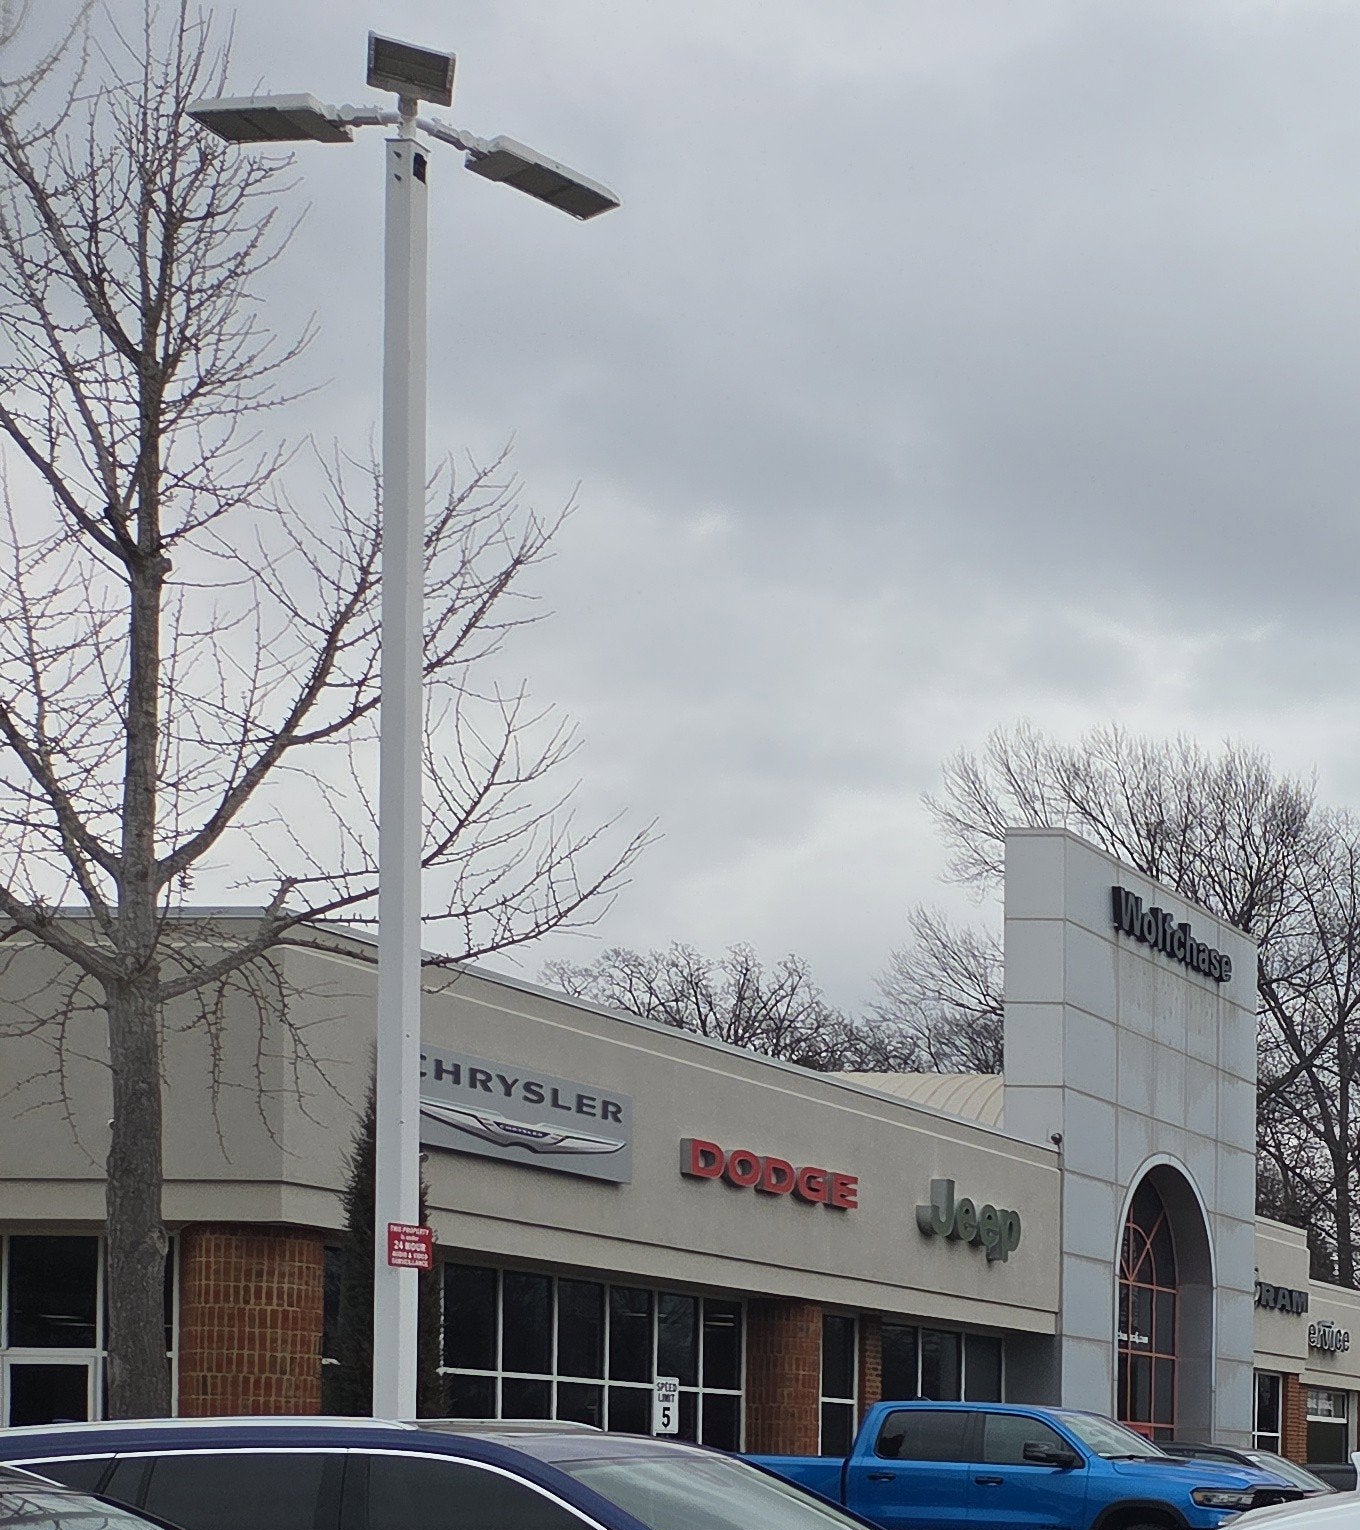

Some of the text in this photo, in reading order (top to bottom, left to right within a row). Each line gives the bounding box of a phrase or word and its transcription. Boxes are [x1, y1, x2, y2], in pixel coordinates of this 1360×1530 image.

[1112, 886, 1232, 982] Wolfchase
[681, 1138, 858, 1210] DODGE
[916, 1178, 1021, 1263] Jeep
[393, 1240, 403, 1249] 24
[1308, 1321, 1349, 1352] ervice
[657, 1382, 677, 1392] SPEED
[658, 1394, 675, 1402] LIMIT
[662, 1406, 671, 1428] 5
